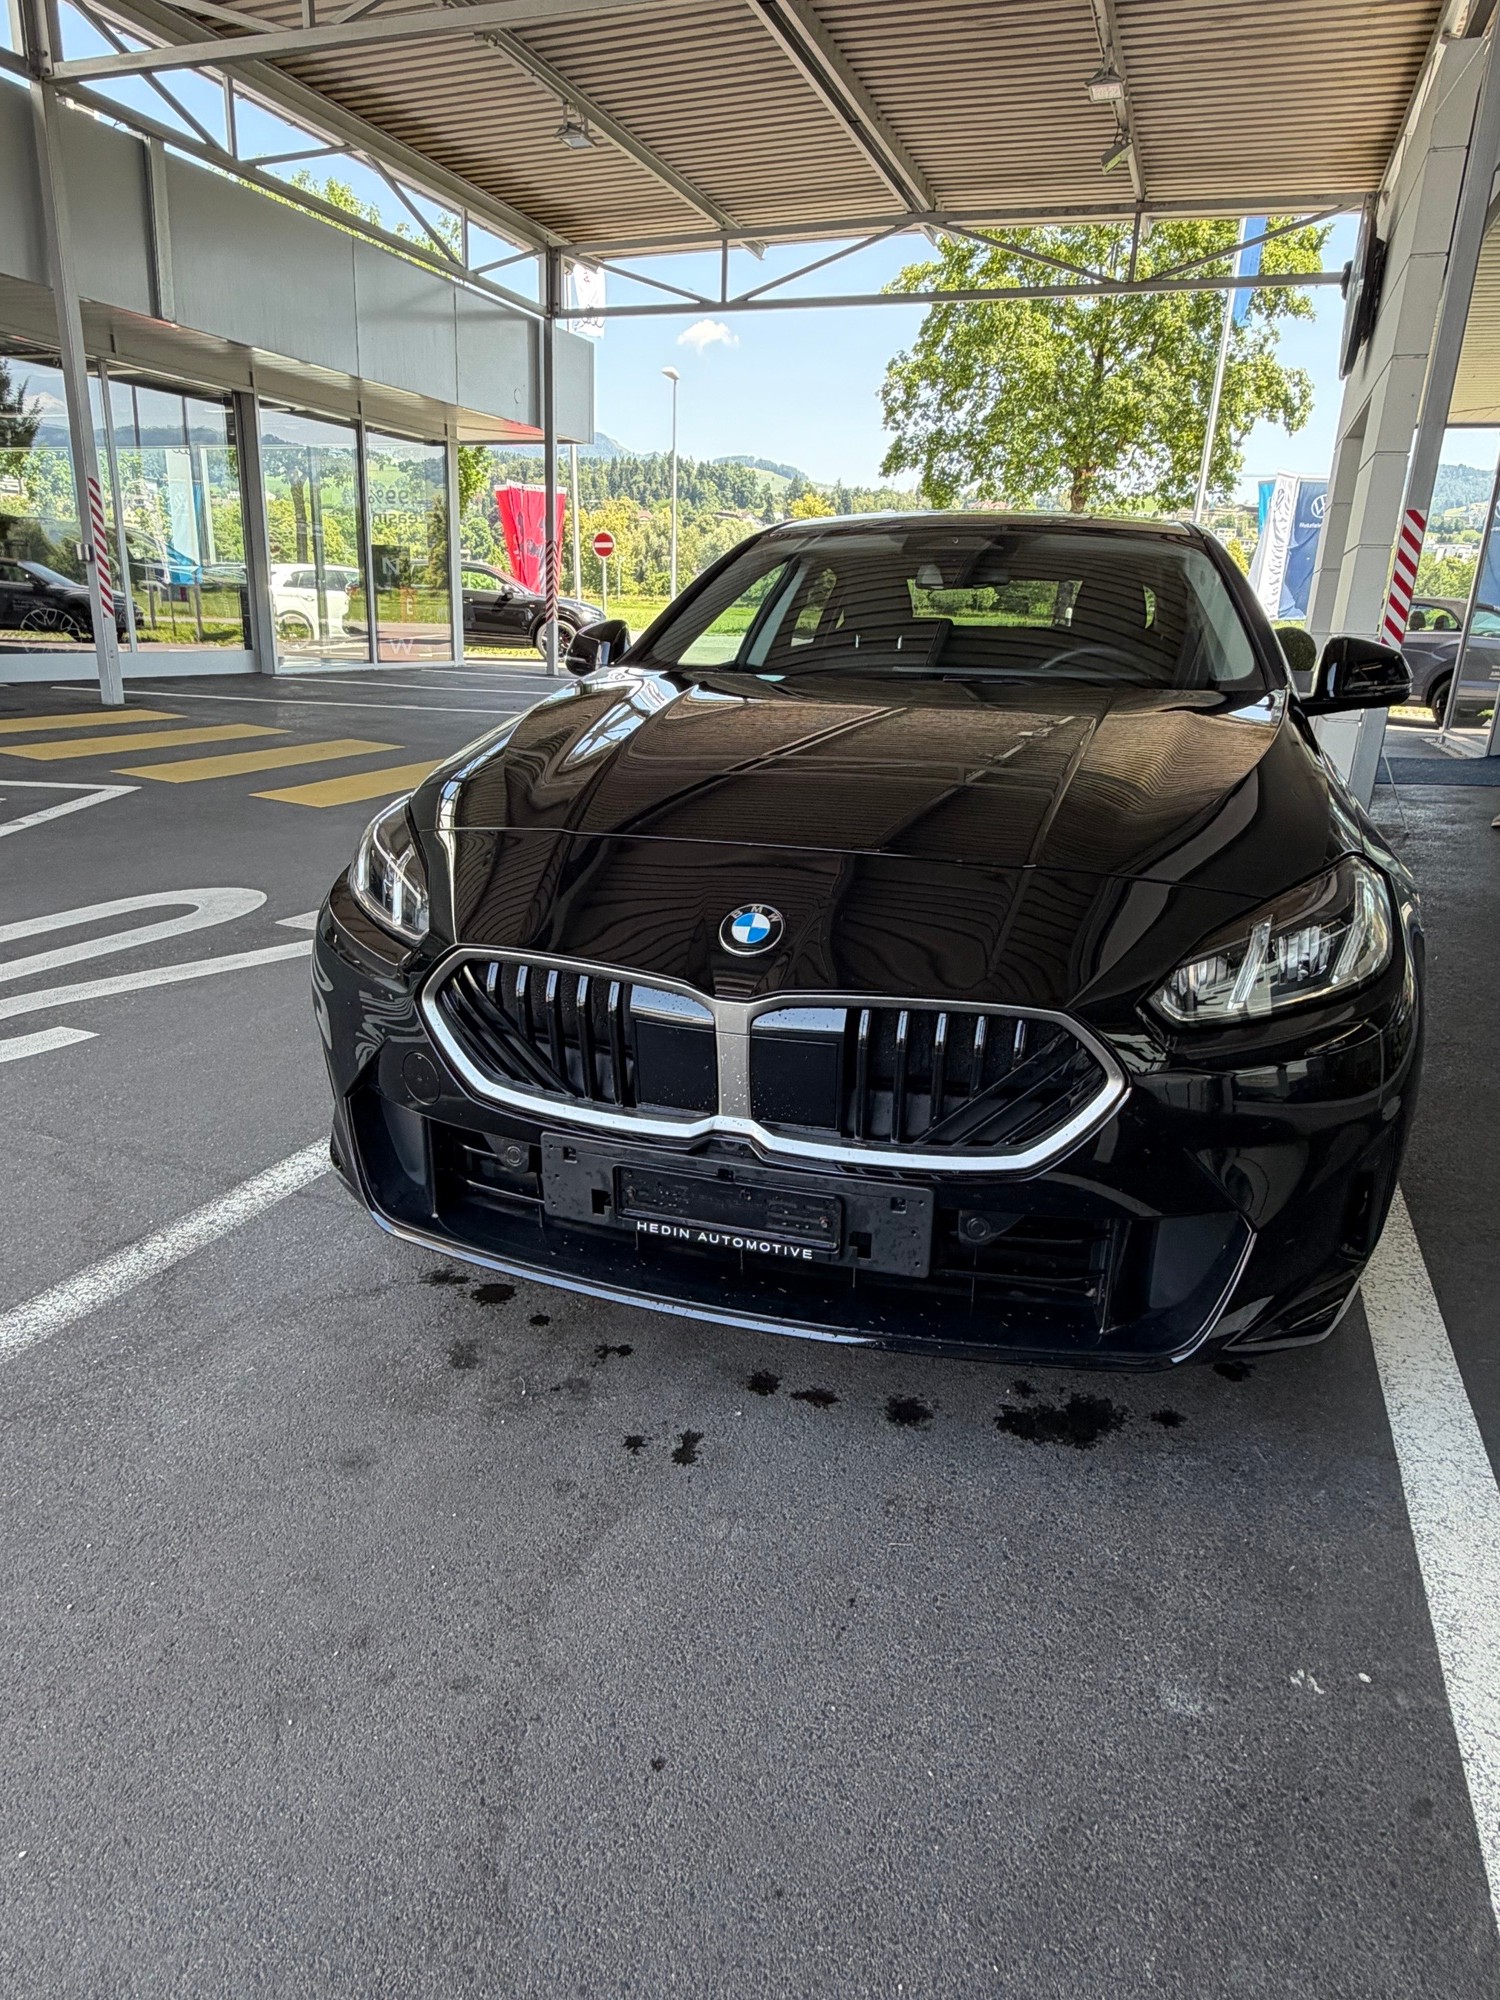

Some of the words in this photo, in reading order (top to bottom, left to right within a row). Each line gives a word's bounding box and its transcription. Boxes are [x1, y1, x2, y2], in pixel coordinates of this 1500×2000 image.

[731, 906, 783, 922] BMW
[637, 1221, 690, 1239] HEDIN
[698, 1232, 813, 1260] AUTOMOTIVE
